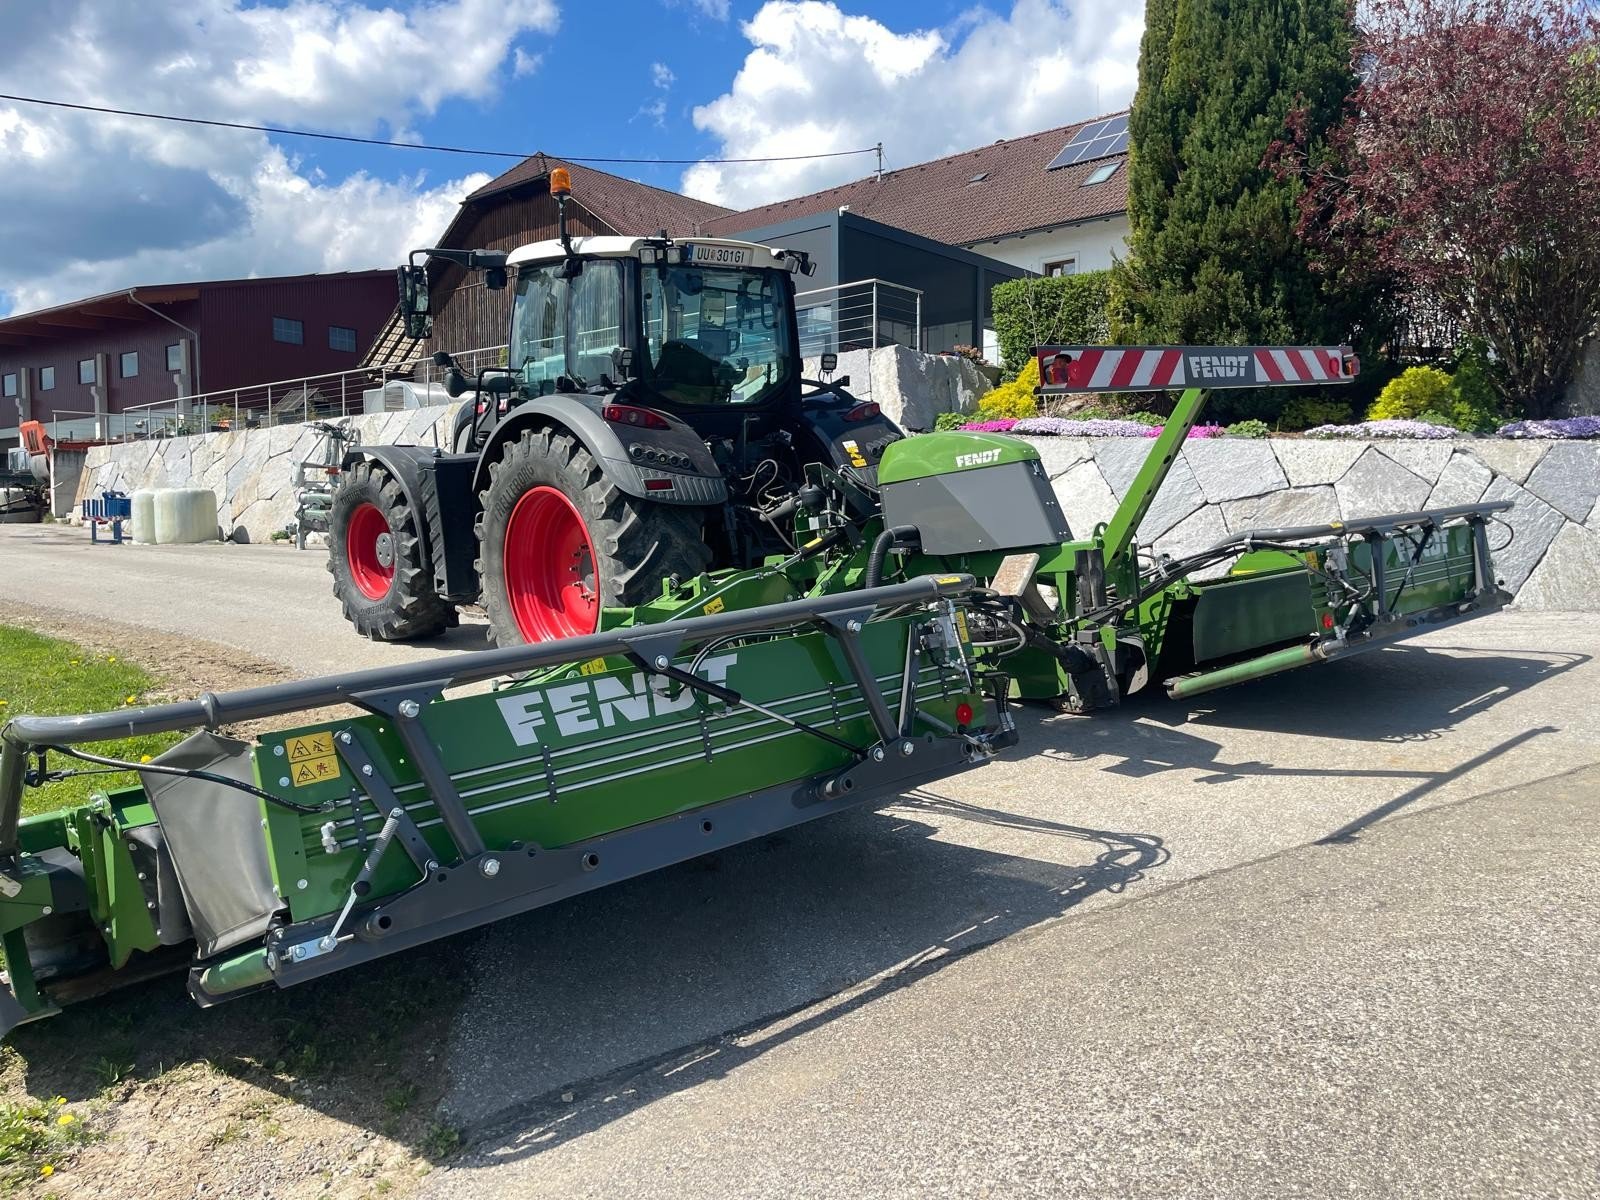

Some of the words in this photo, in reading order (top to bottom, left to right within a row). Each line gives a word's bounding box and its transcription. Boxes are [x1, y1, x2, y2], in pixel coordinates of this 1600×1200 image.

[697, 247, 710, 260] UU
[1188, 355, 1249, 378] FENDT
[955, 447, 1002, 468] FENDT
[495, 652, 738, 747] FENDT
